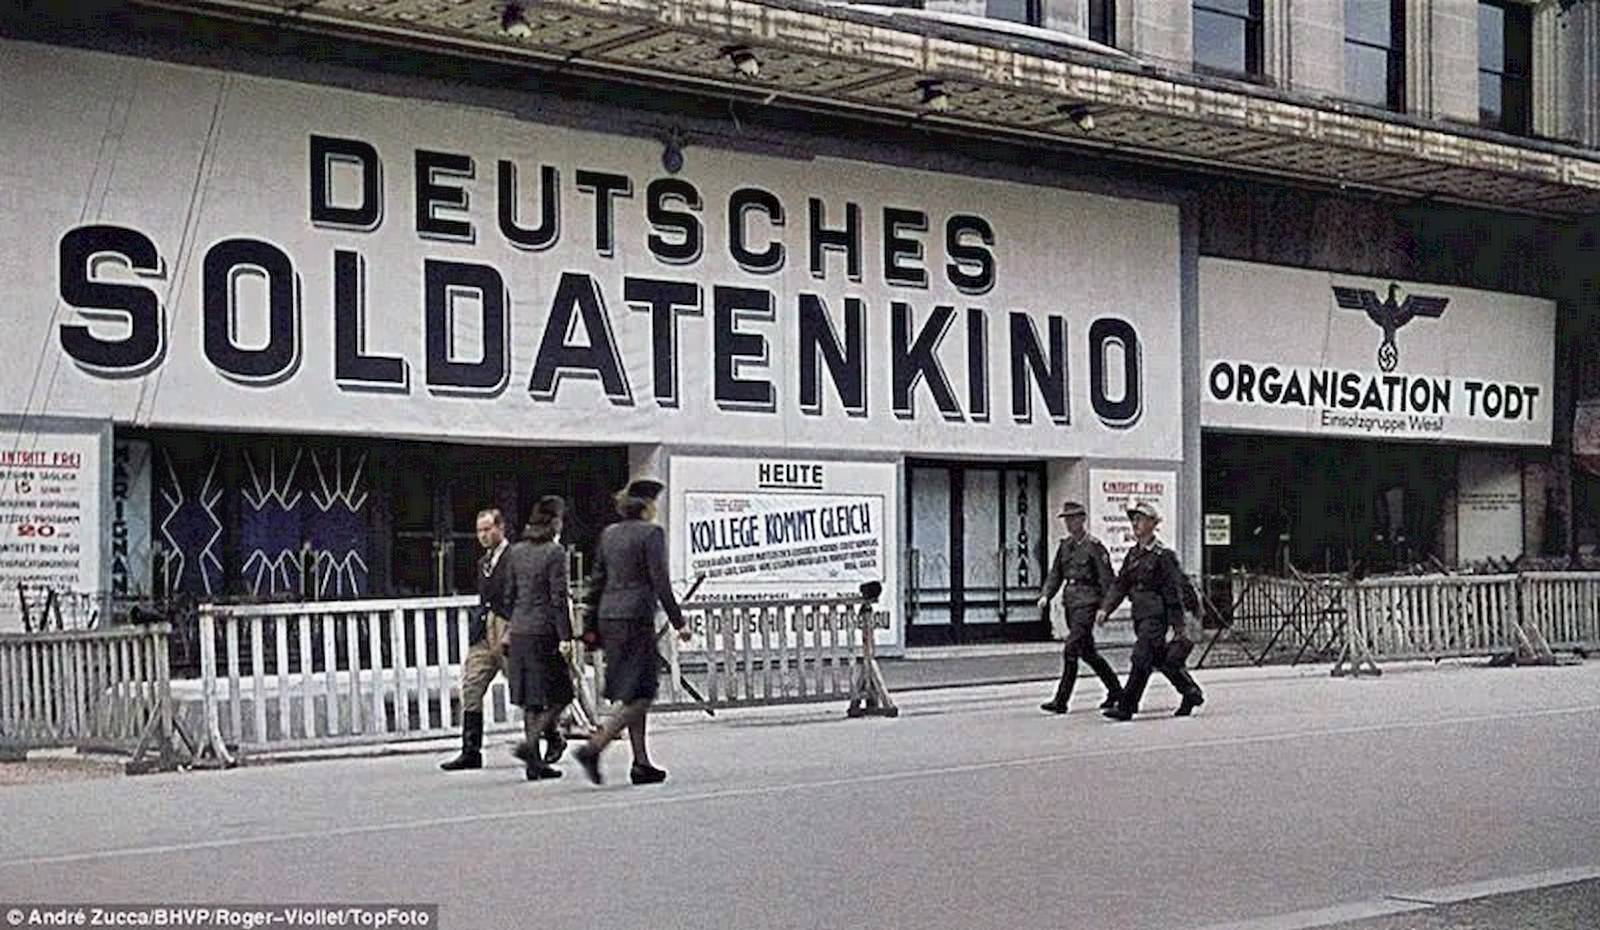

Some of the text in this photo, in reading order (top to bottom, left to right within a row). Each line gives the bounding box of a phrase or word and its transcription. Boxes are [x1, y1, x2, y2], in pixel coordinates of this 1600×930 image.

[310, 134, 995, 295] DEUTSCHES
[59, 225, 1143, 428] SOLDATENKINO
[1209, 362, 1539, 420] ORGANISATION TODT
[1321, 410, 1444, 432] Einsatzgruppe West
[758, 464, 823, 484] HEUTE
[690, 502, 871, 554] KOLLEGE KOMMT GLEICH
